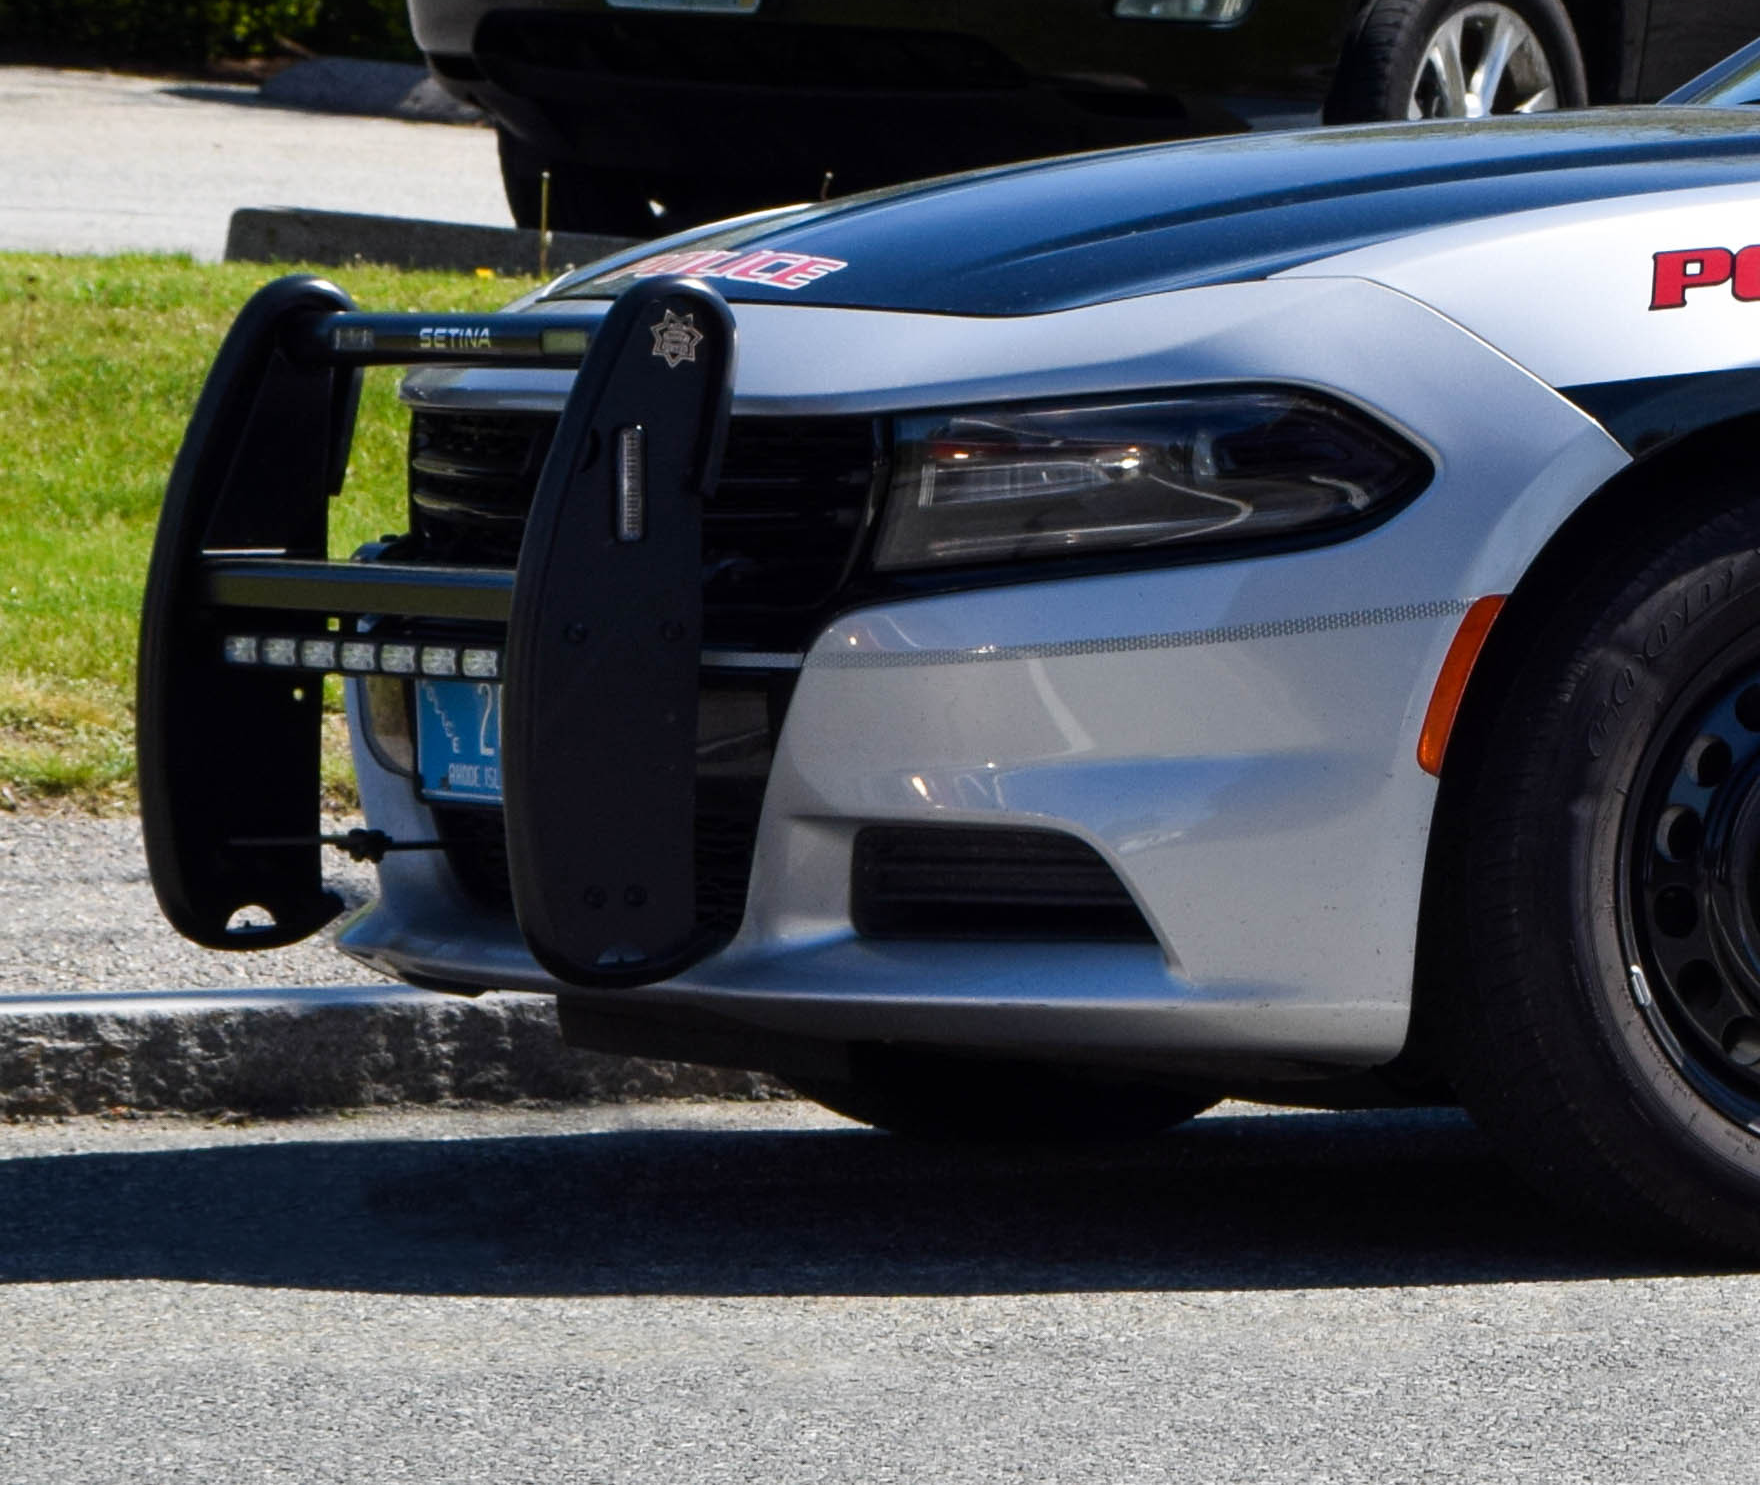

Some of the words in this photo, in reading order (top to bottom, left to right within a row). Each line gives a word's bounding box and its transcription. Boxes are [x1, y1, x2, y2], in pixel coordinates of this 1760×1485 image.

[593, 249, 849, 290] POLICE
[418, 327, 492, 349] SETINA
[477, 682, 504, 757] 2
[448, 762, 481, 788] RHODE
